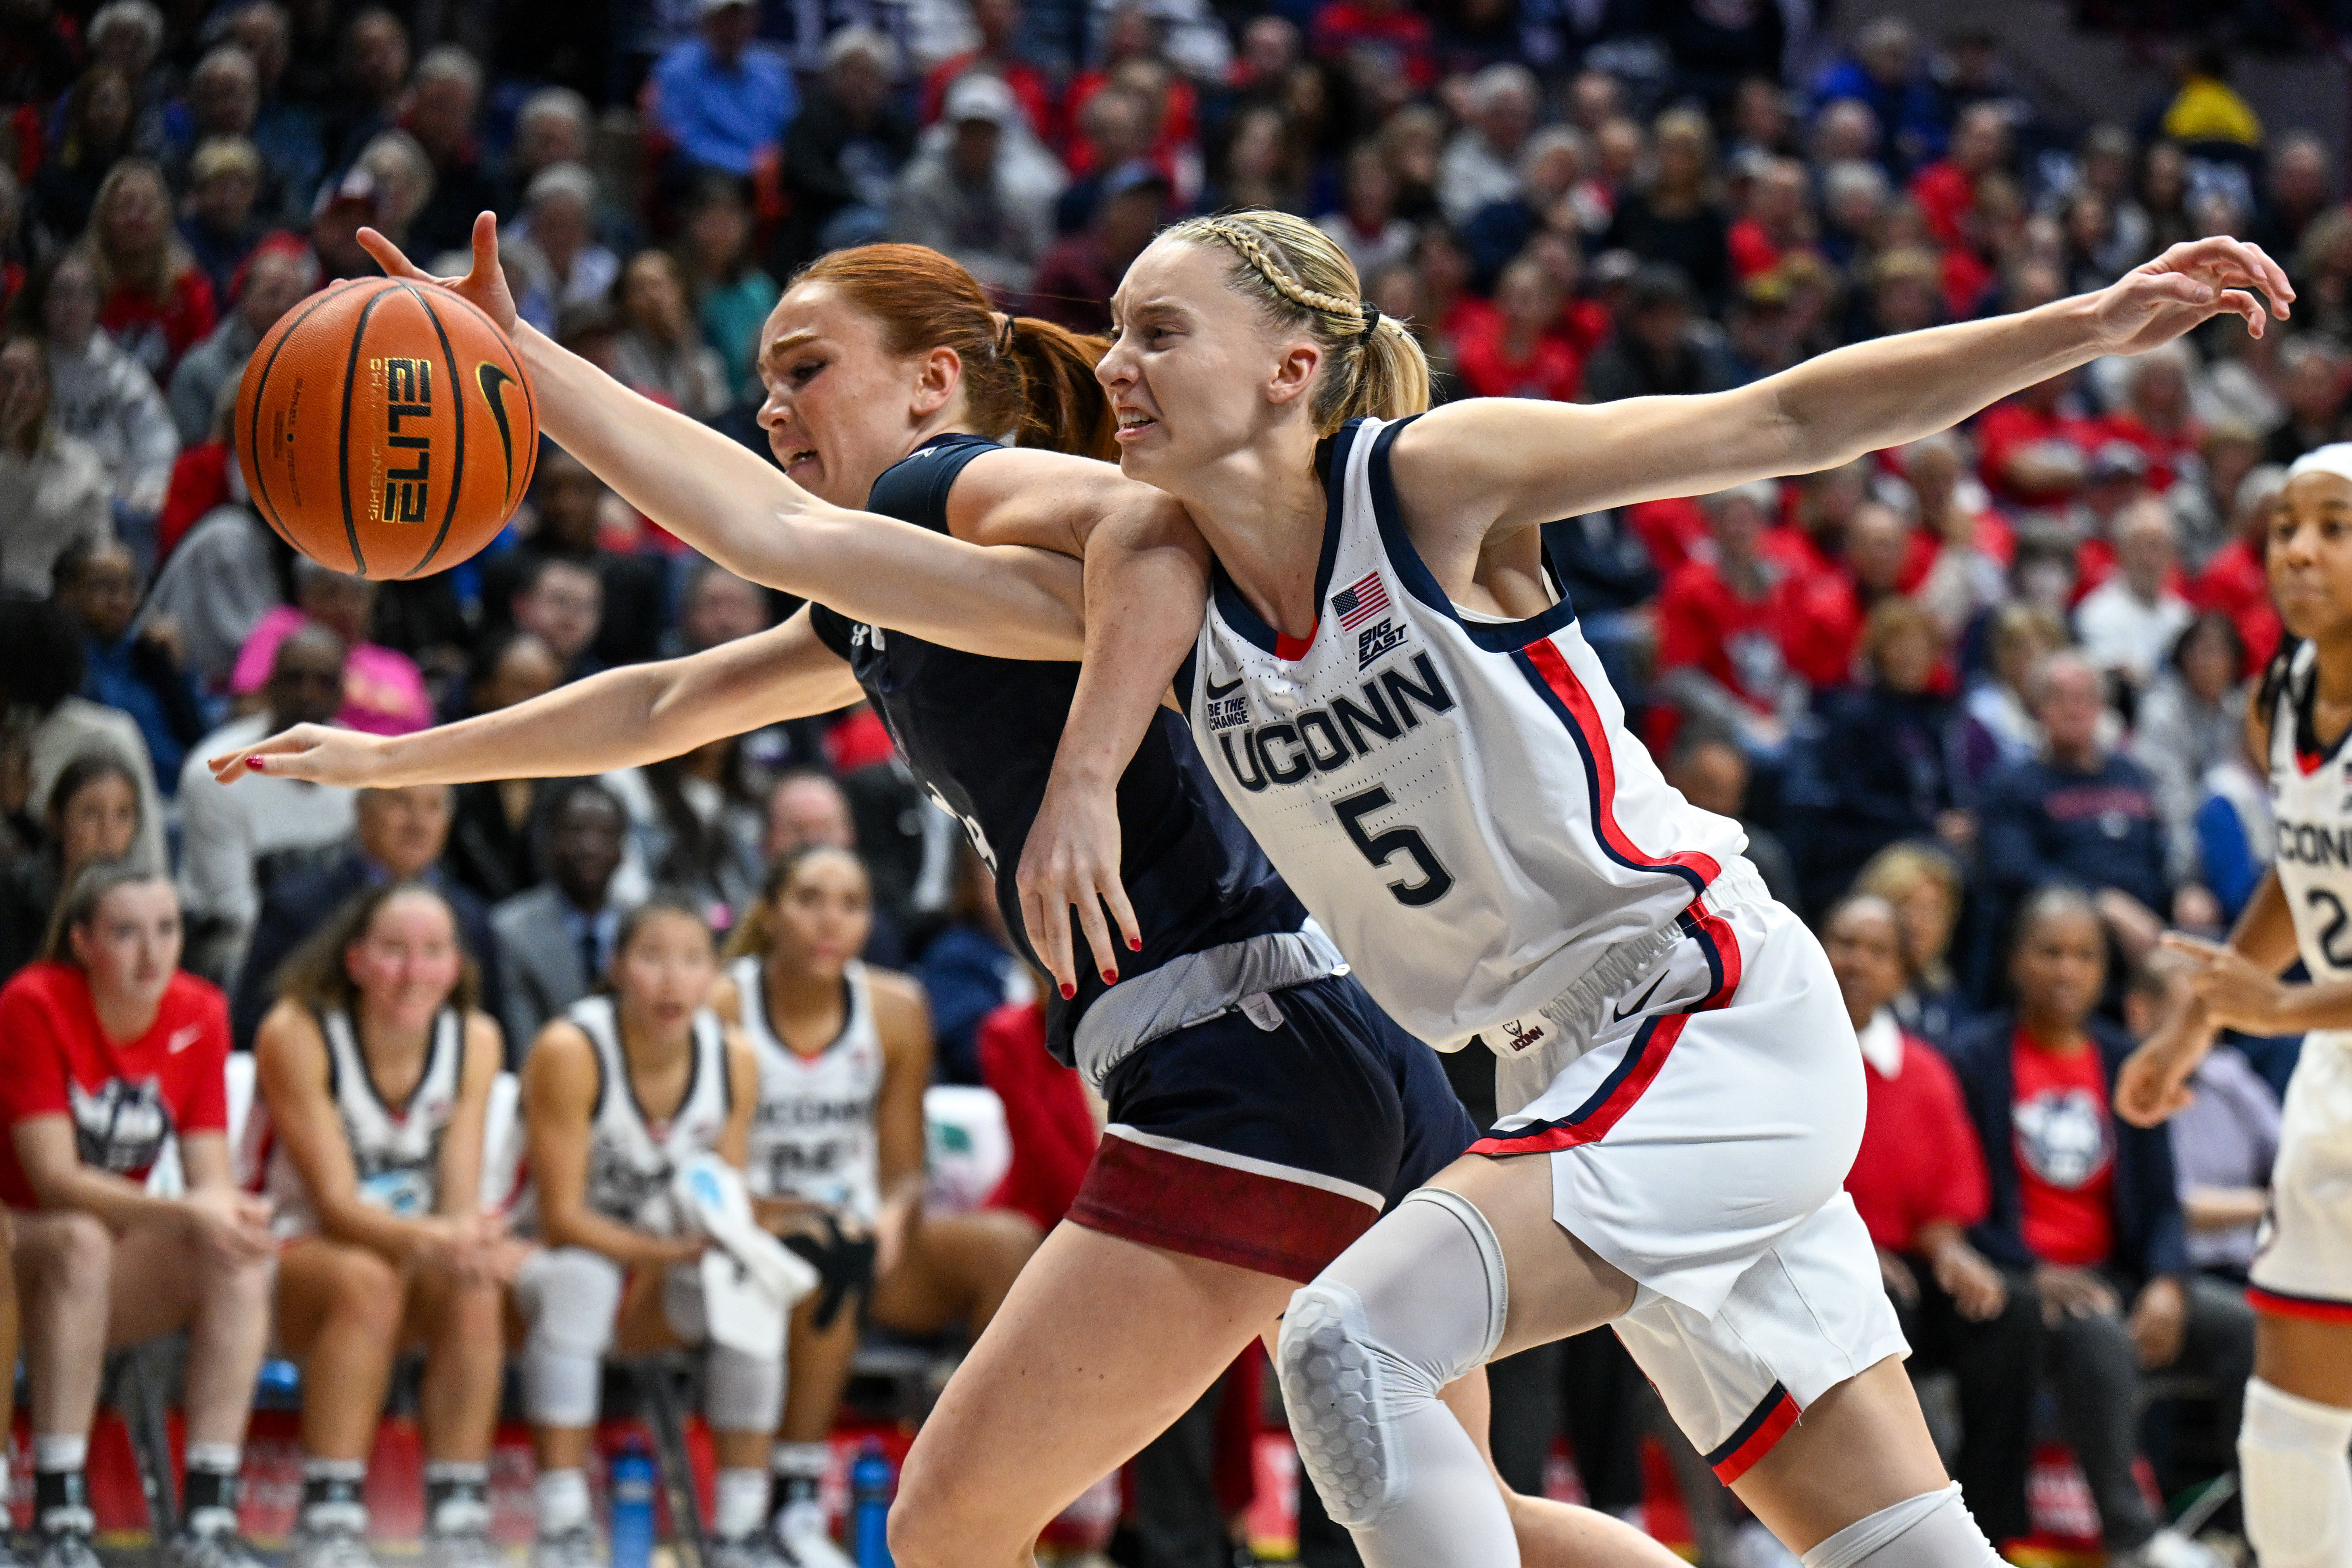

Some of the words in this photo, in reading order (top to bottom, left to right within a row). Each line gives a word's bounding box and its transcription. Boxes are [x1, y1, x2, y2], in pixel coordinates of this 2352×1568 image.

[381, 357, 432, 524] ELITE
[1359, 617, 1391, 648] BIG
[1359, 624, 1407, 663] EAST
[1207, 702, 1221, 717] BE
[1224, 697, 1245, 713] THE
[1209, 710, 1250, 731] CHANGE
[1219, 648, 1457, 794] UCONN
[1330, 781, 1455, 908] 5
[1510, 1026, 1544, 1051] UCONN
